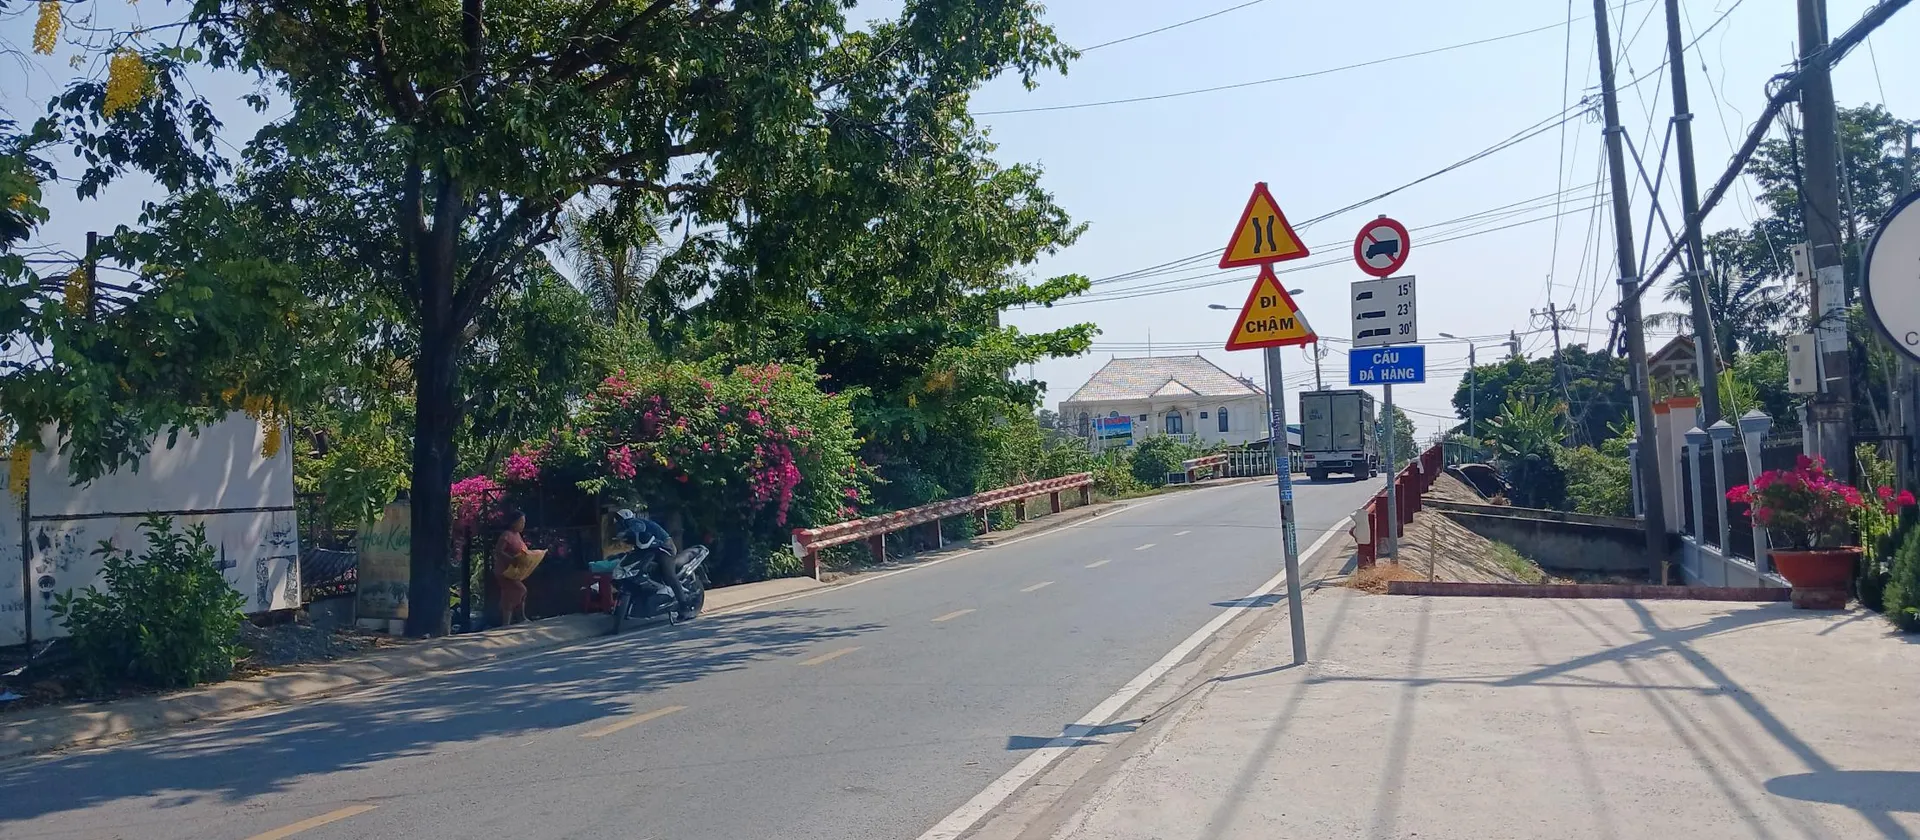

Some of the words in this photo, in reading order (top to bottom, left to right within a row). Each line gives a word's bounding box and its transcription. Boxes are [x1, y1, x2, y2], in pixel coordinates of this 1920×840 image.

[1260, 295, 1277, 308] ĐI
[1246, 316, 1294, 334] CHẬM
[1372, 349, 1399, 364] CẦU
[1360, 366, 1375, 381] ĐÁ
[1381, 366, 1415, 380] HÀNG
[360, 525, 383, 552] Hoa
